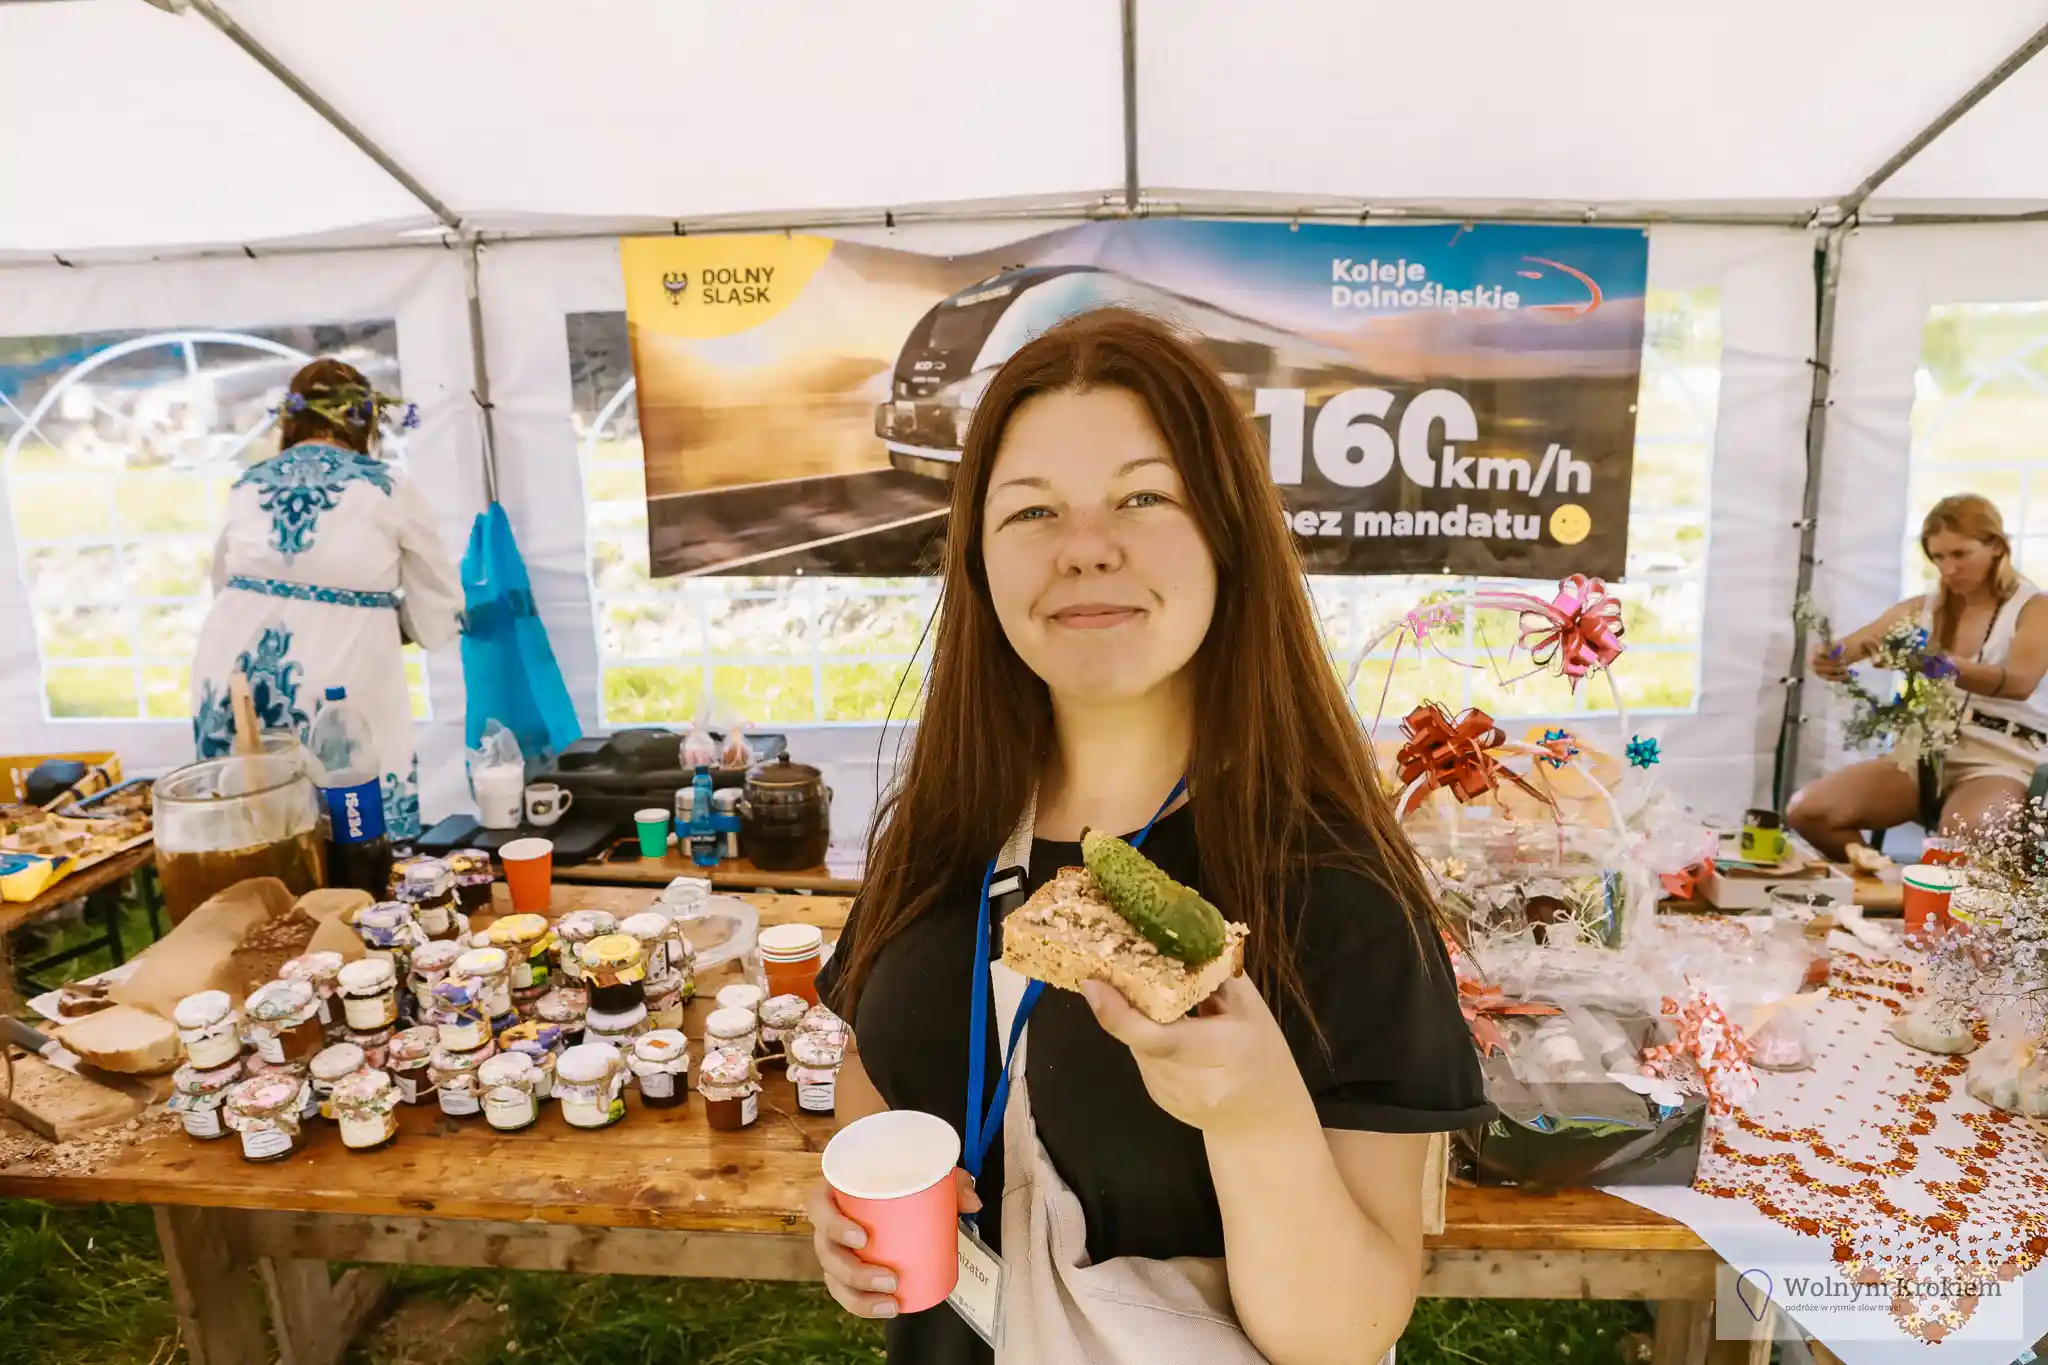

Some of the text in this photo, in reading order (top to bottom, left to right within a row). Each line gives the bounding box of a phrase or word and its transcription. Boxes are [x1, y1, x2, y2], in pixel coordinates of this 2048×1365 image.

[702, 266, 775, 285] DOLNY
[1331, 258, 1426, 287] Koleje
[1331, 282, 1520, 315] Dolnośląskie
[1353, 504, 1541, 540] mandatu
